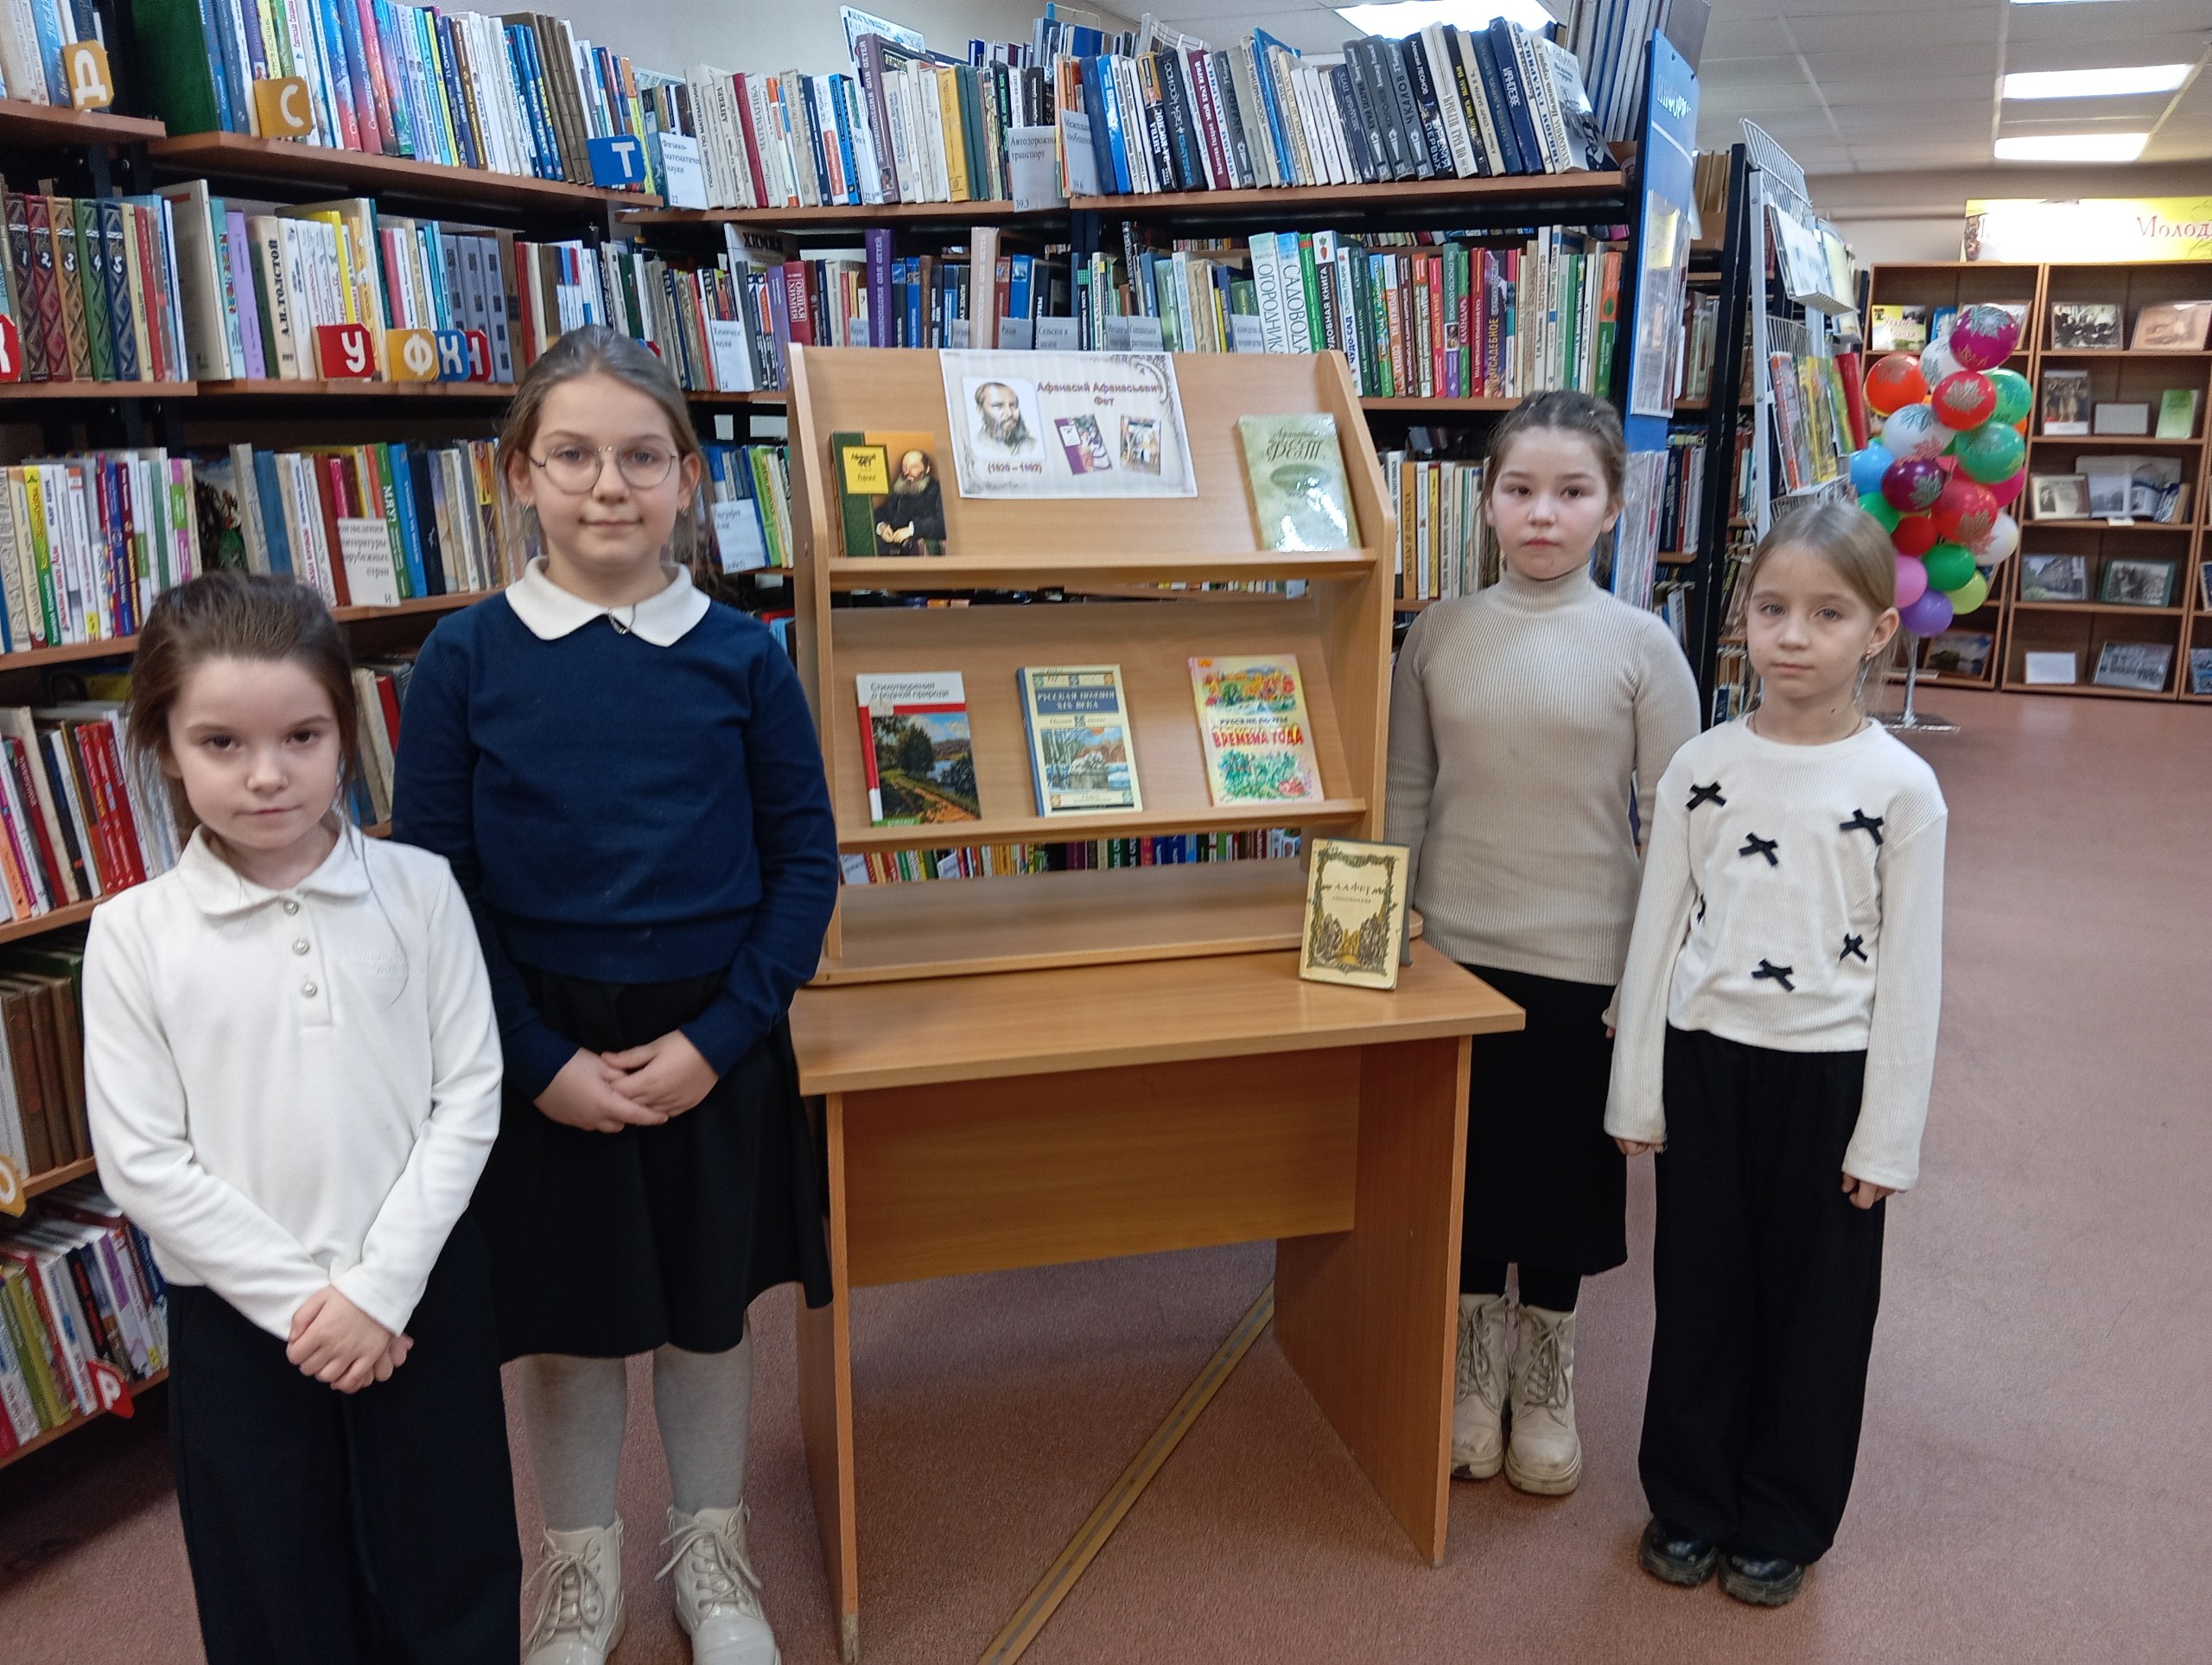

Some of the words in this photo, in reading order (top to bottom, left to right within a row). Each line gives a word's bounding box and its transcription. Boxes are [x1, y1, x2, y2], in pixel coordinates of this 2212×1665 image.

[860, 41, 869, 69] ДЕТЕЙ
[74, 49, 107, 105] Д
[1416, 67, 1429, 95] ЛЕОНОВ
[1502, 66, 1521, 107] ЗВЕЗДНЫЙ
[280, 84, 304, 128] С
[691, 81, 704, 134] МАТЕМАТИКЕ
[716, 86, 728, 123] АЛГЕБРА
[751, 85, 766, 151] МАТЕМАТИКА
[1396, 74, 1414, 125] ЧКАЛОВ
[868, 91, 884, 163] ЭНЦИКЛОПЕДИЯ
[1149, 121, 1161, 154] БИТВА
[1425, 123, 1443, 170] ПЕРВЫХ
[1432, 118, 1452, 169] ВРЕМЯ
[611, 141, 636, 178] Т
[1011, 151, 1046, 162] транспорт
[671, 194, 678, 204] 22
[1015, 199, 1030, 209] 39.3
[41, 251, 52, 268] 2
[64, 252, 75, 272] 3
[113, 256, 123, 274] 5
[874, 236, 883, 264] ДЕТЕЙ
[268, 238, 288, 308] ТОЛСТОЙ
[1319, 265, 1331, 302] КНИГА
[787, 280, 798, 321] ХИМИЯ
[795, 279, 807, 320] ОБЩАЯ
[1257, 264, 1284, 354] ОГОРОДНИК
[1345, 315, 1357, 364] ЧУДО-САД
[1387, 289, 1399, 323] УРОЖАЙ
[1393, 345, 1404, 374] СОТКАХ
[1459, 297, 1467, 344] КАЛЕНДАРЬ
[341, 331, 366, 373] У
[404, 333, 434, 376] Ф
[438, 334, 463, 375] Х
[1487, 317, 1499, 378] УСАДЕБНОЕ
[1037, 380, 1090, 395] Афанасий
[1094, 397, 1115, 406] Фет
[1212, 730, 1268, 747] ВРЕМЕНА
[1272, 726, 1304, 747] ГОДА
